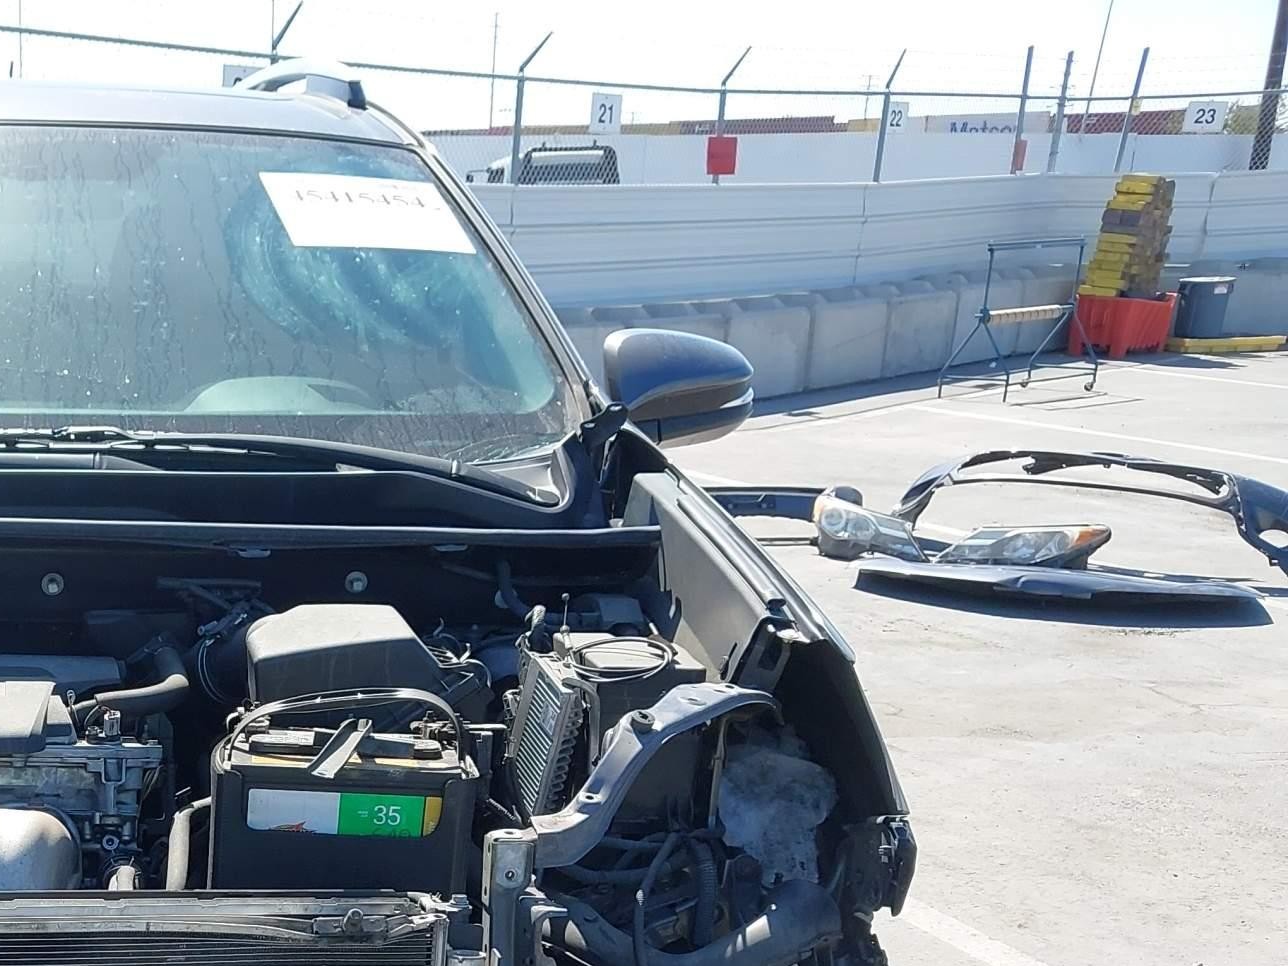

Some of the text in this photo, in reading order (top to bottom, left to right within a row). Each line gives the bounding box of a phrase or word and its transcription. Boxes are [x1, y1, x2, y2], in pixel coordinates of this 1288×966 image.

[597, 103, 614, 124] 21
[889, 110, 903, 127] 22
[1193, 108, 1217, 125] 23
[373, 805, 402, 826] 35
